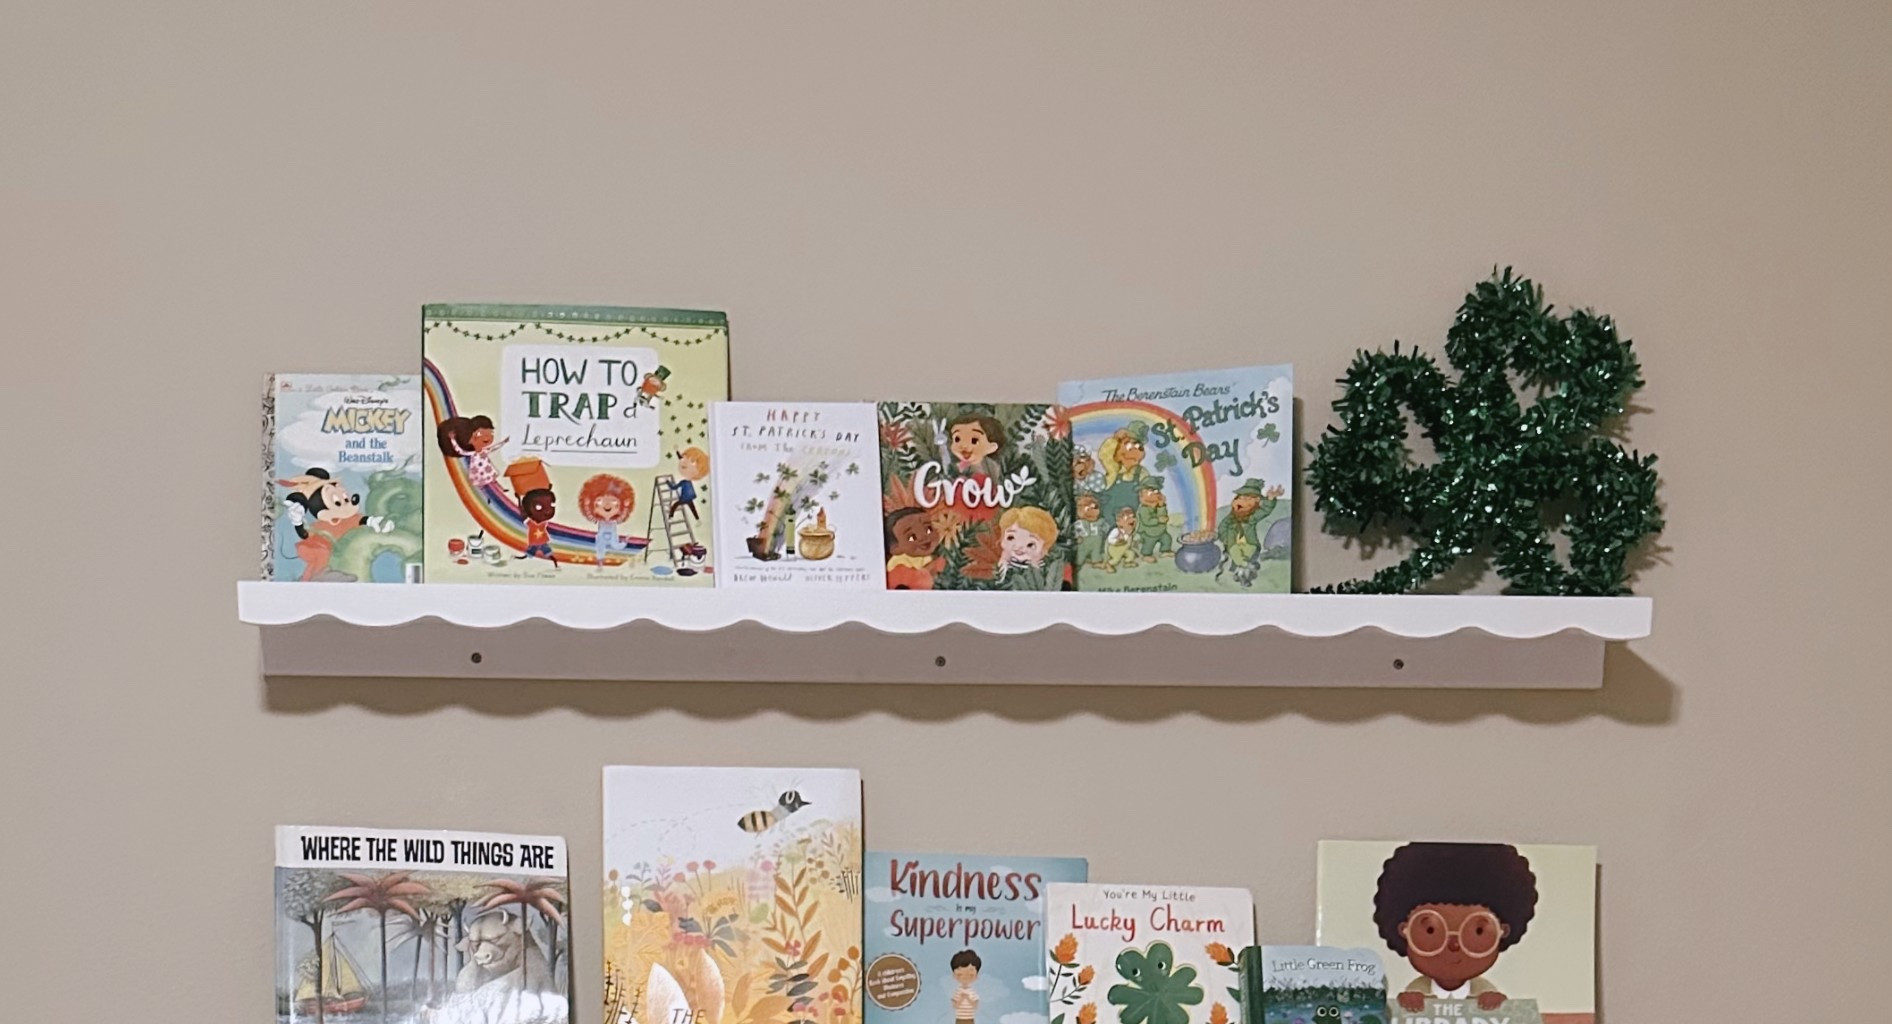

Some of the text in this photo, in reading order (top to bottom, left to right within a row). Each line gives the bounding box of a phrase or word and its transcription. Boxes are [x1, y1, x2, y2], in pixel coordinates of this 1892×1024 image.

[521, 357, 638, 386] HOW TO
[521, 391, 618, 426] TRAP
[1102, 389, 1125, 403] The
[1127, 387, 1190, 401] Berenstain
[321, 405, 412, 434] MICKEY
[767, 409, 820, 423] HAPPY
[1152, 390, 1280, 448] St. Patrick's
[345, 438, 387, 449] and the
[521, 423, 637, 451] Leprechaun
[835, 432, 859, 442] DAY
[338, 451, 394, 463] Beanstalk
[1182, 439, 1243, 477] Day
[914, 460, 1026, 508] Grow
[301, 835, 554, 869] WHERE THE WILD THINGS ARE
[890, 859, 1042, 901] Kindness
[1103, 889, 1196, 902] You're My Little
[890, 909, 1041, 947] Superpower
[1072, 903, 1225, 942] Lucky Charm
[1272, 958, 1376, 976] Little Green Frog
[673, 1009, 706, 1024] THE
[1432, 1003, 1463, 1016] THE
